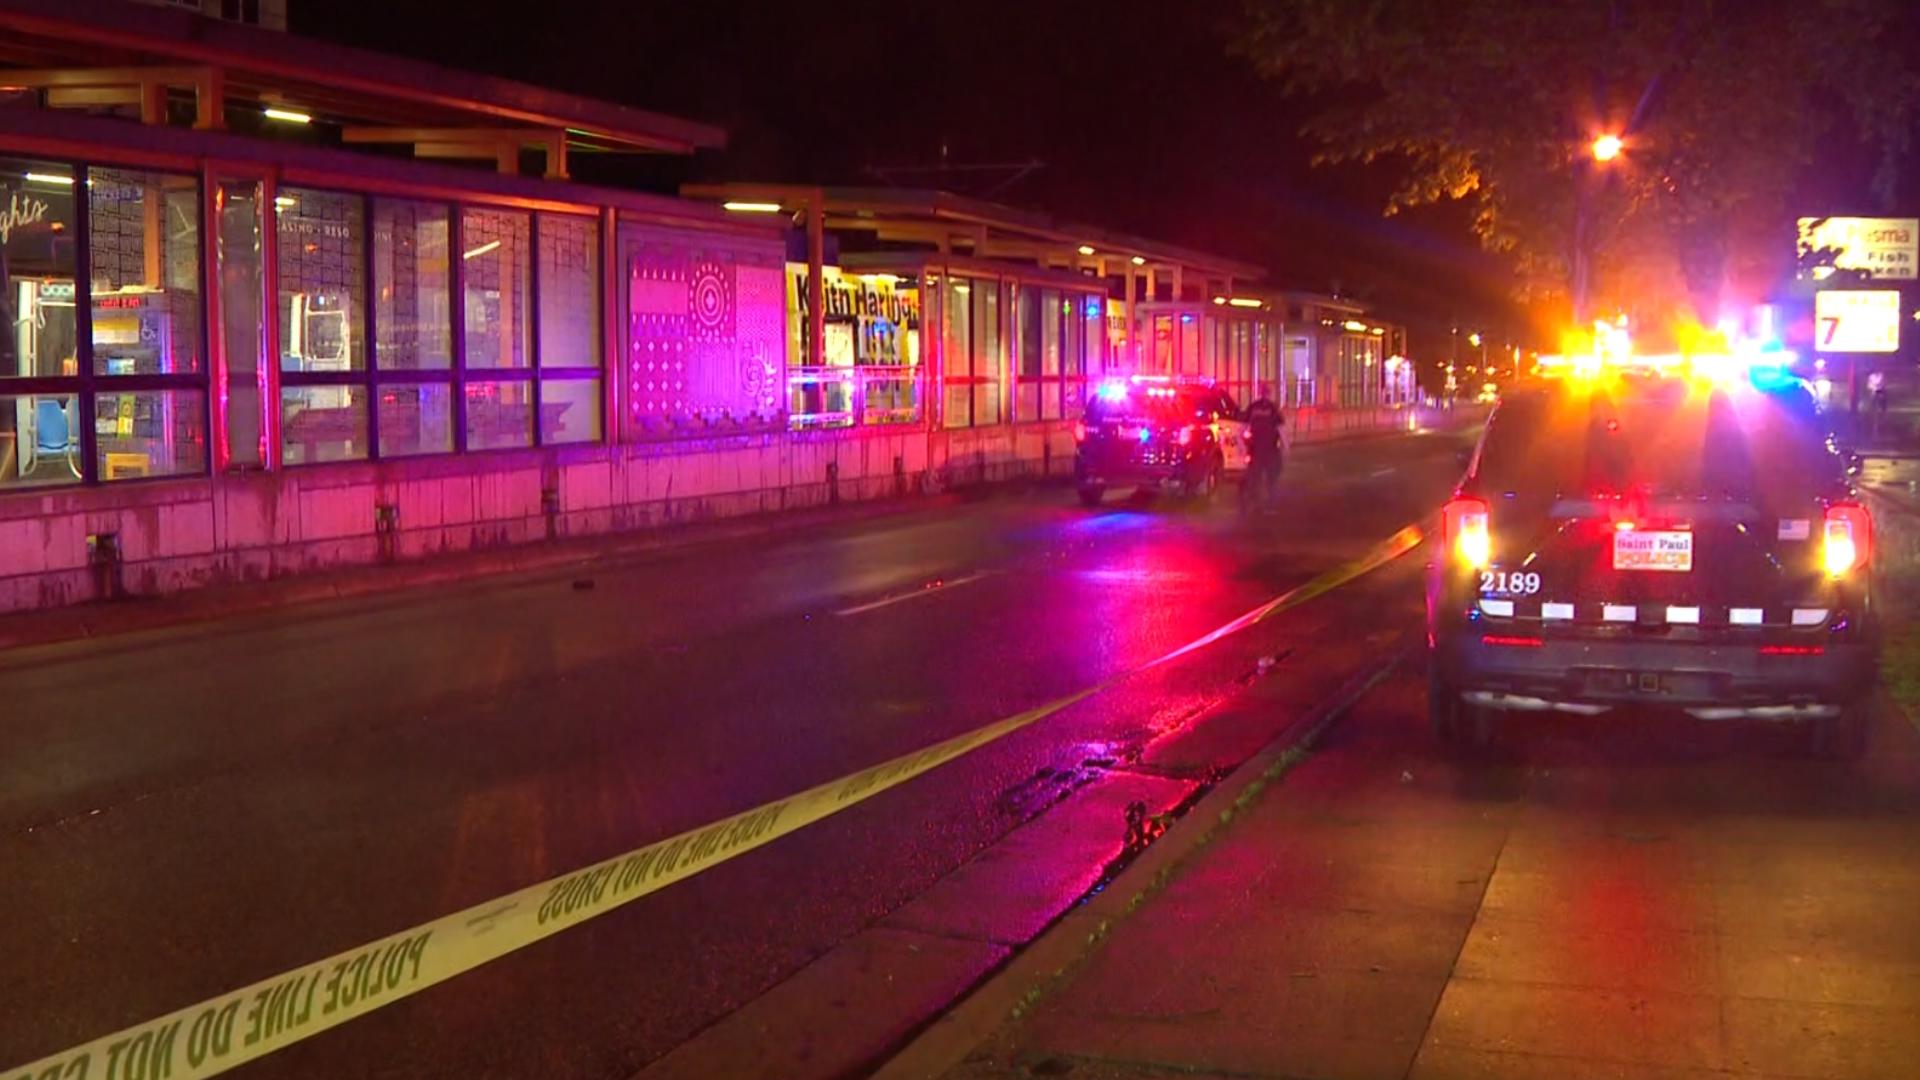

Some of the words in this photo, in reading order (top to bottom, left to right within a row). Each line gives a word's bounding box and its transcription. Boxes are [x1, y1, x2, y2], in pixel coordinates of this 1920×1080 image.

[277, 221, 314, 234] ASINO
[1868, 229, 1911, 243] sma
[796, 274, 851, 316] Kith
[1821, 316, 1840, 345] 7
[1617, 538, 1653, 550] Saint
[1659, 538, 1689, 550] Paul
[1480, 571, 1540, 594] 2189
